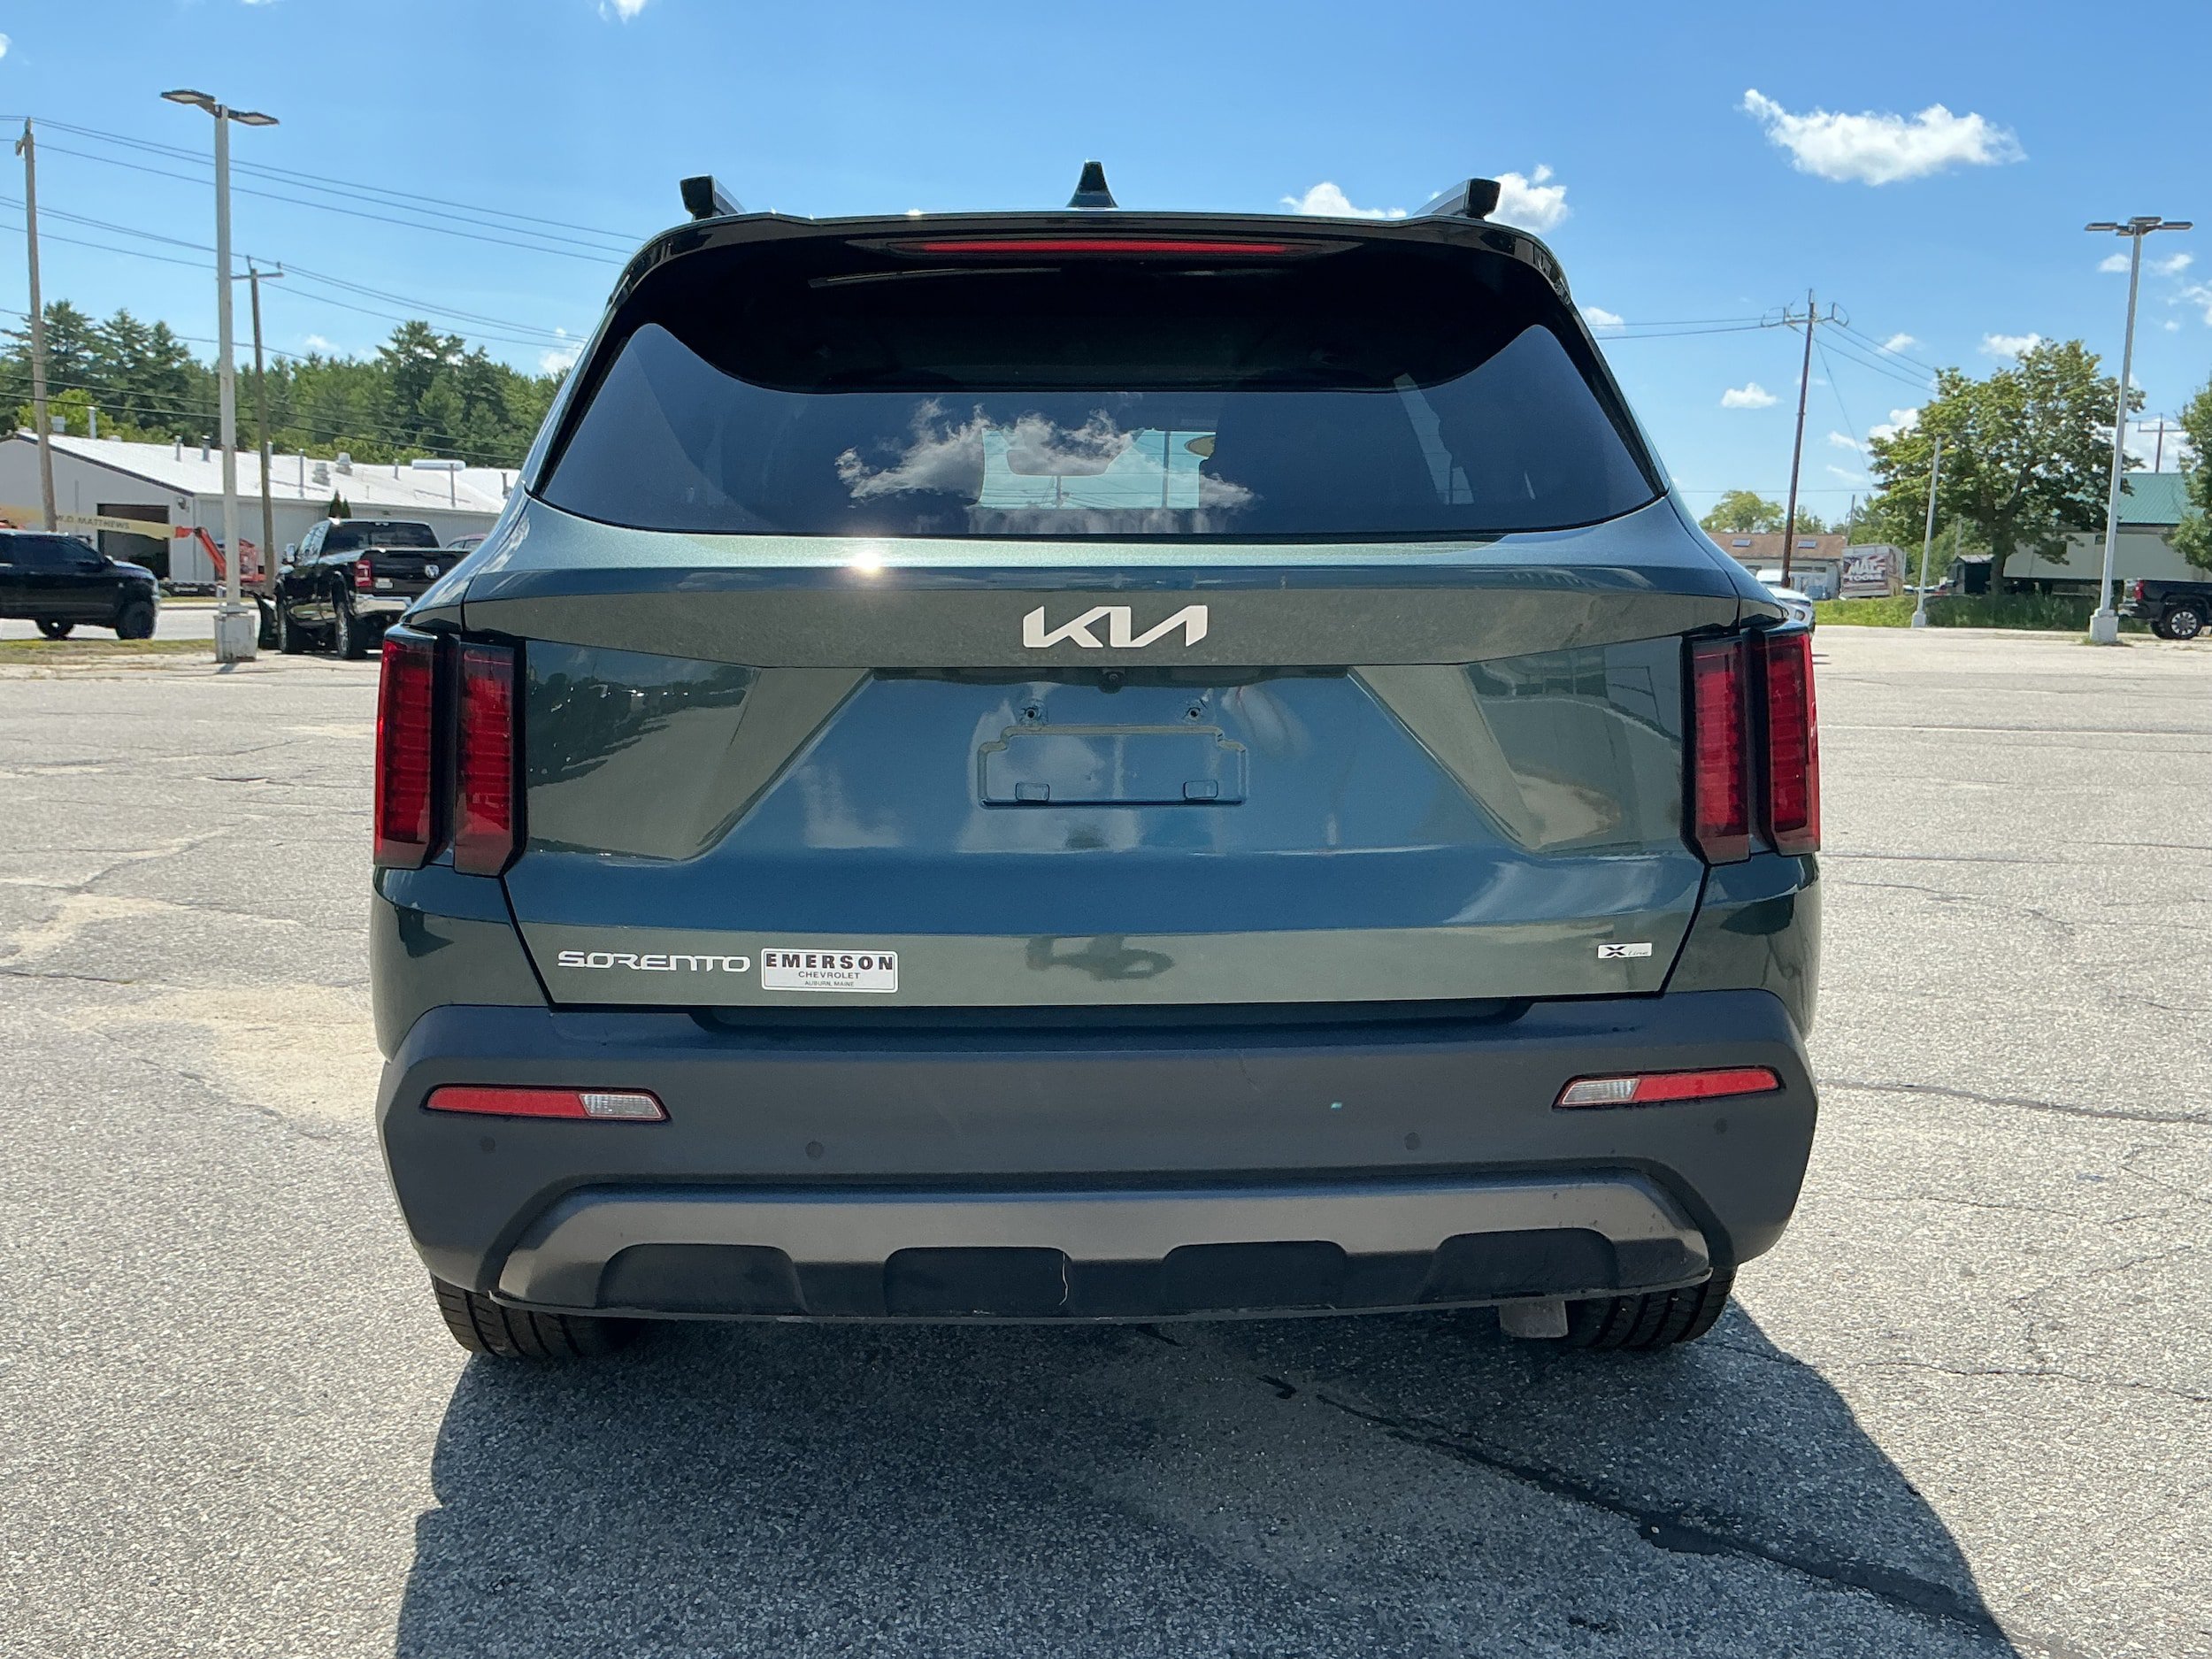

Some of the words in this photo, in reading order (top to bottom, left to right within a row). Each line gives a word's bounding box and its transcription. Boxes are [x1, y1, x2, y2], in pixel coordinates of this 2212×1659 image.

[78, 517, 130, 530] MATTHEWS
[1022, 604, 1209, 649] KIA
[557, 949, 751, 973] SORENTO
[765, 953, 894, 971] EMERSON
[798, 971, 861, 979] CHEVROLET
